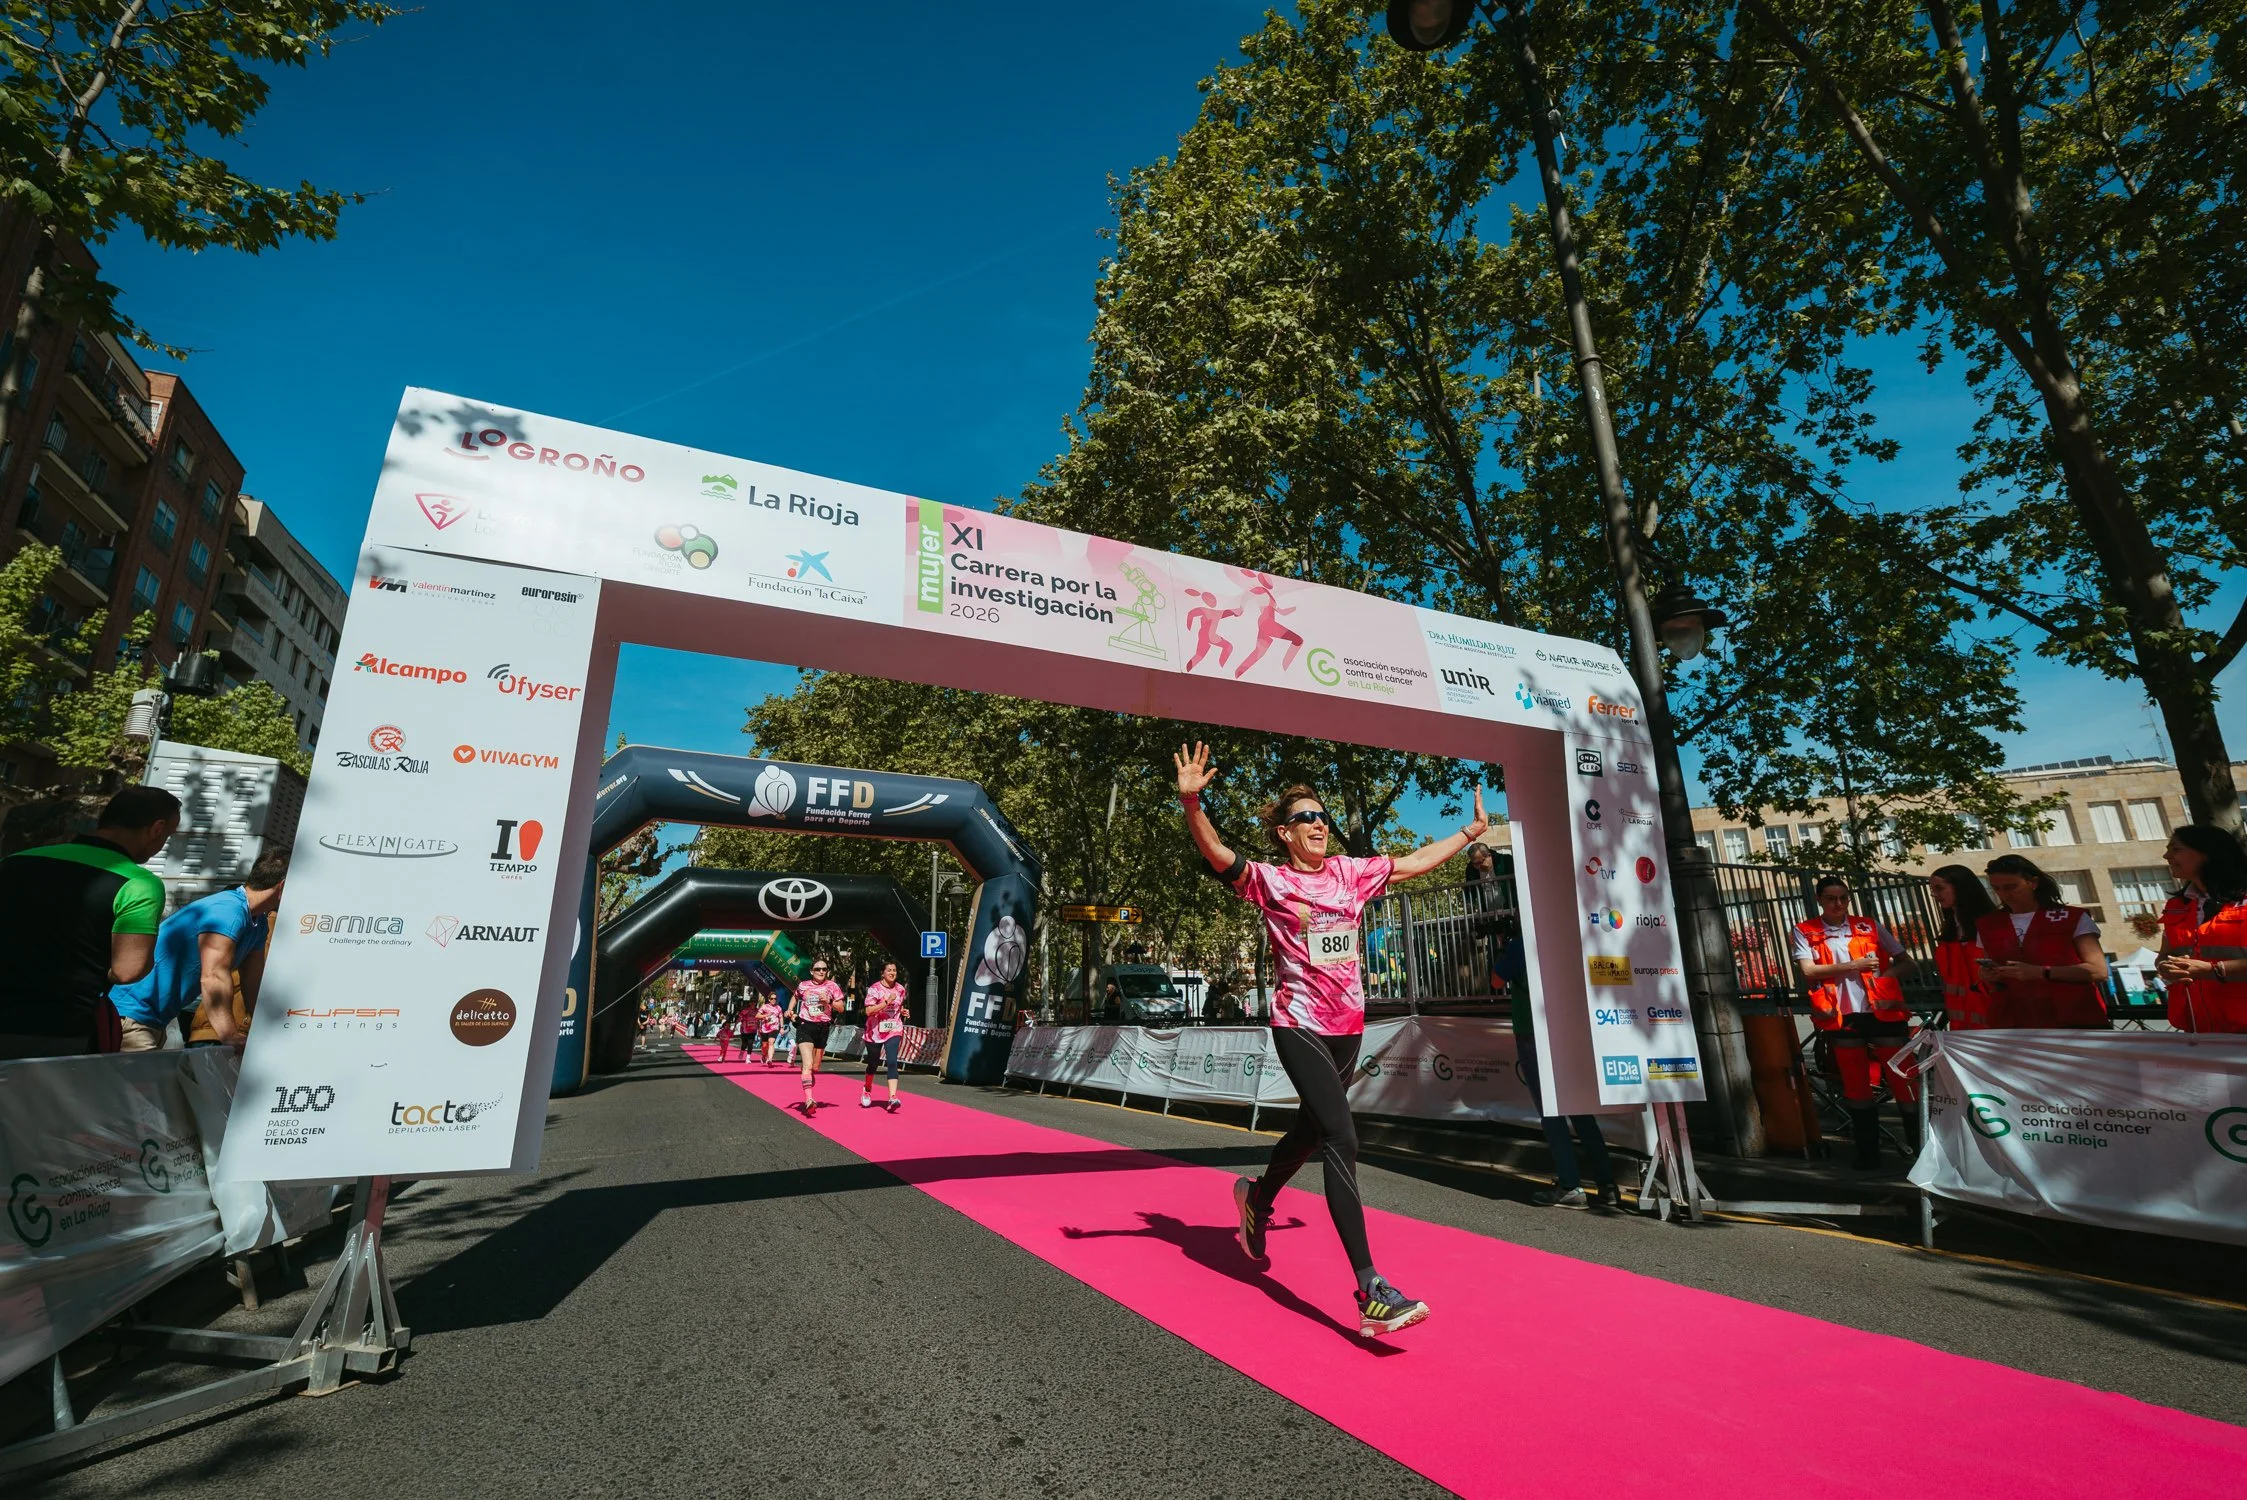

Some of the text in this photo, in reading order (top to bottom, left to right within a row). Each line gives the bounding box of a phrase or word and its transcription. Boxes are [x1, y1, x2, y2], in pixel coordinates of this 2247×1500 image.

[461, 429, 645, 482] LOGROÑO
[749, 485, 860, 527] La Rioja
[950, 523, 983, 550] XI
[917, 525, 945, 604] mujer
[950, 552, 1117, 602] Carrera por la
[749, 577, 812, 598] Fundación
[950, 576, 1114, 625] investigación
[950, 603, 1000, 624] 2026
[1448, 634, 1496, 650] HUMILDAD
[1496, 644, 1517, 655] RUIZ
[354, 653, 468, 684] Alcampo
[1343, 657, 1428, 678] asociación española
[1549, 653, 1609, 671] NATUR HOUSE
[1345, 668, 1413, 686] contra el cáncer
[499, 674, 581, 701] Ofyser
[1348, 680, 1395, 695] en La Rioja
[1533, 695, 1571, 710] viamed
[394, 756, 429, 774] RIOJA
[480, 749, 559, 770] VIVAGYM
[1617, 761, 1639, 774] SER
[807, 777, 875, 809] FFD
[806, 807, 872, 819] Fundación Ferrer
[839, 818, 870, 826] Deporte
[489, 862, 538, 873] TEMPLO
[1600, 868, 1616, 880] tvr
[1121, 910, 1129, 920] P
[1636, 914, 1667, 928] rioja2
[300, 914, 404, 935] garnica
[328, 937, 366, 946] Challenge
[381, 939, 412, 947] ordinary
[455, 925, 540, 943] ARNAUT
[926, 935, 942, 951] P
[1321, 935, 1350, 954] 880
[1634, 968, 1679, 976] europa press
[287, 1008, 400, 1018] KUPSA
[456, 1009, 510, 1021] delicatto
[1596, 1009, 1620, 1025] 941
[1647, 1006, 1682, 1018] Gente
[284, 1020, 398, 1030] coatings
[964, 1026, 979, 1034] para
[965, 1018, 998, 1029] Fundación
[1606, 1061, 1638, 1076] El Día
[270, 1085, 336, 1114] 100
[391, 1099, 477, 1126] tacto
[2021, 1101, 2187, 1123] asociación española
[268, 1119, 300, 1127] PASEO
[388, 1125, 445, 1134] DEPILACIÓN
[2021, 1116, 2152, 1136] contra el cáncer
[265, 1127, 326, 1137] DE LAS CIEN
[2022, 1131, 2109, 1149] en La Rioja
[264, 1136, 308, 1146] TIENDAS
[74, 1211, 87, 1225] La
